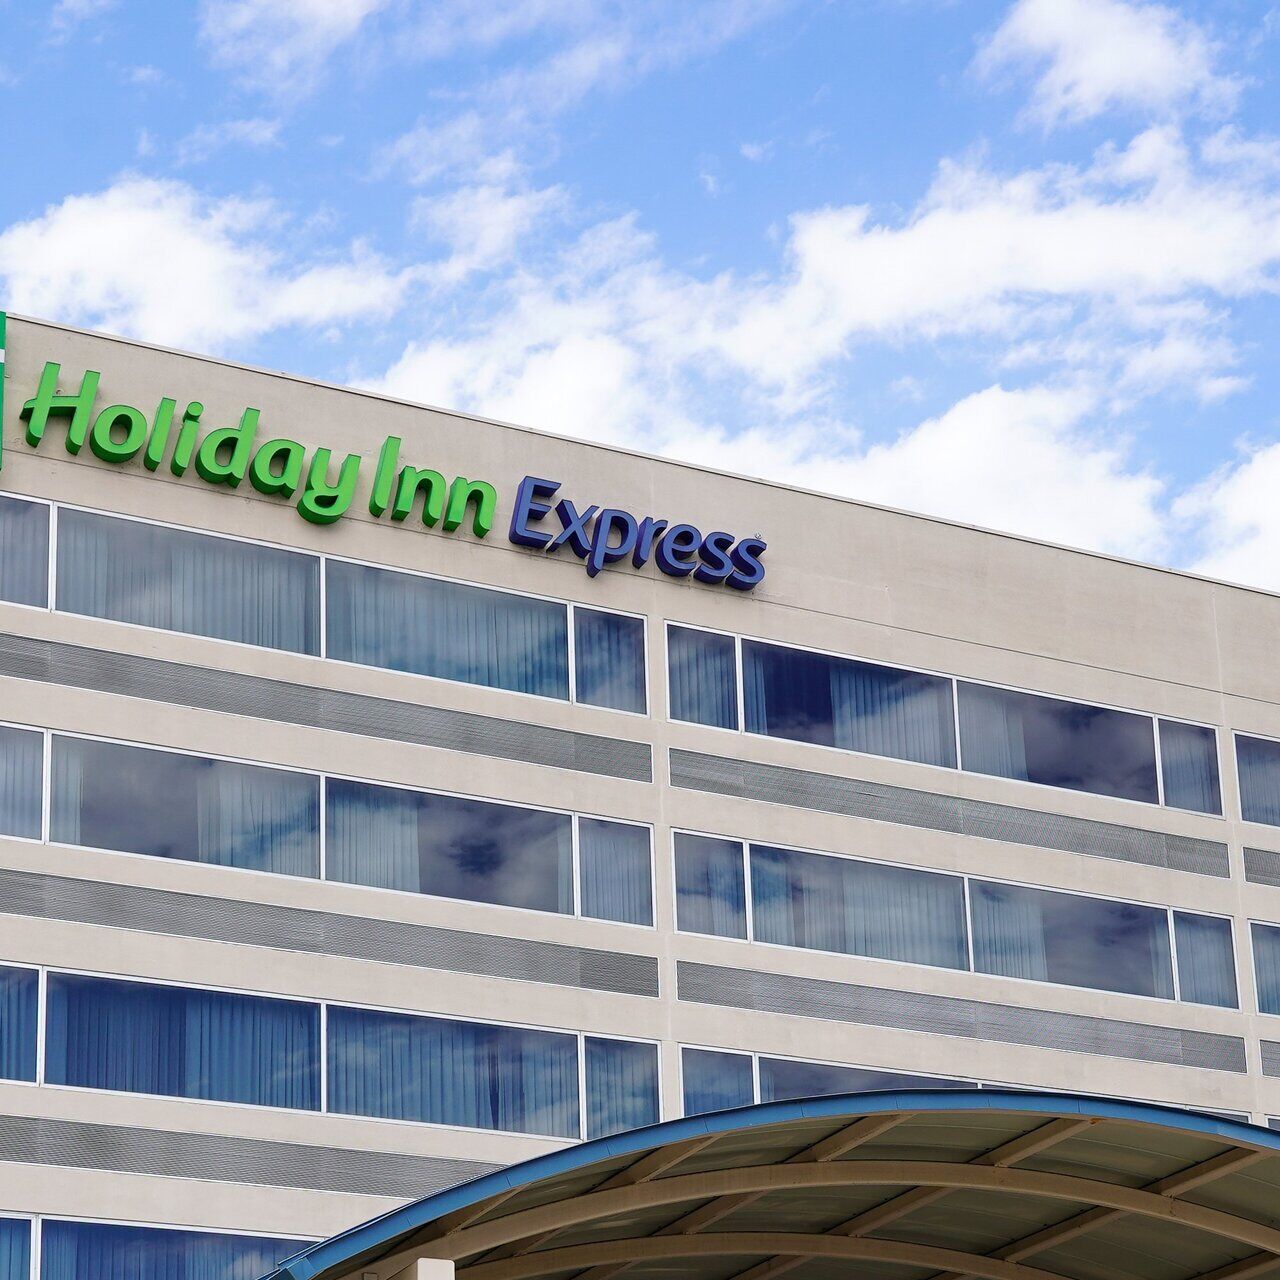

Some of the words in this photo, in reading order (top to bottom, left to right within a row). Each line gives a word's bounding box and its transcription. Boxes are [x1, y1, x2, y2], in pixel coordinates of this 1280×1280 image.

[19, 361, 362, 525] Holiday
[369, 435, 497, 539] Inn
[508, 475, 767, 591] Express
